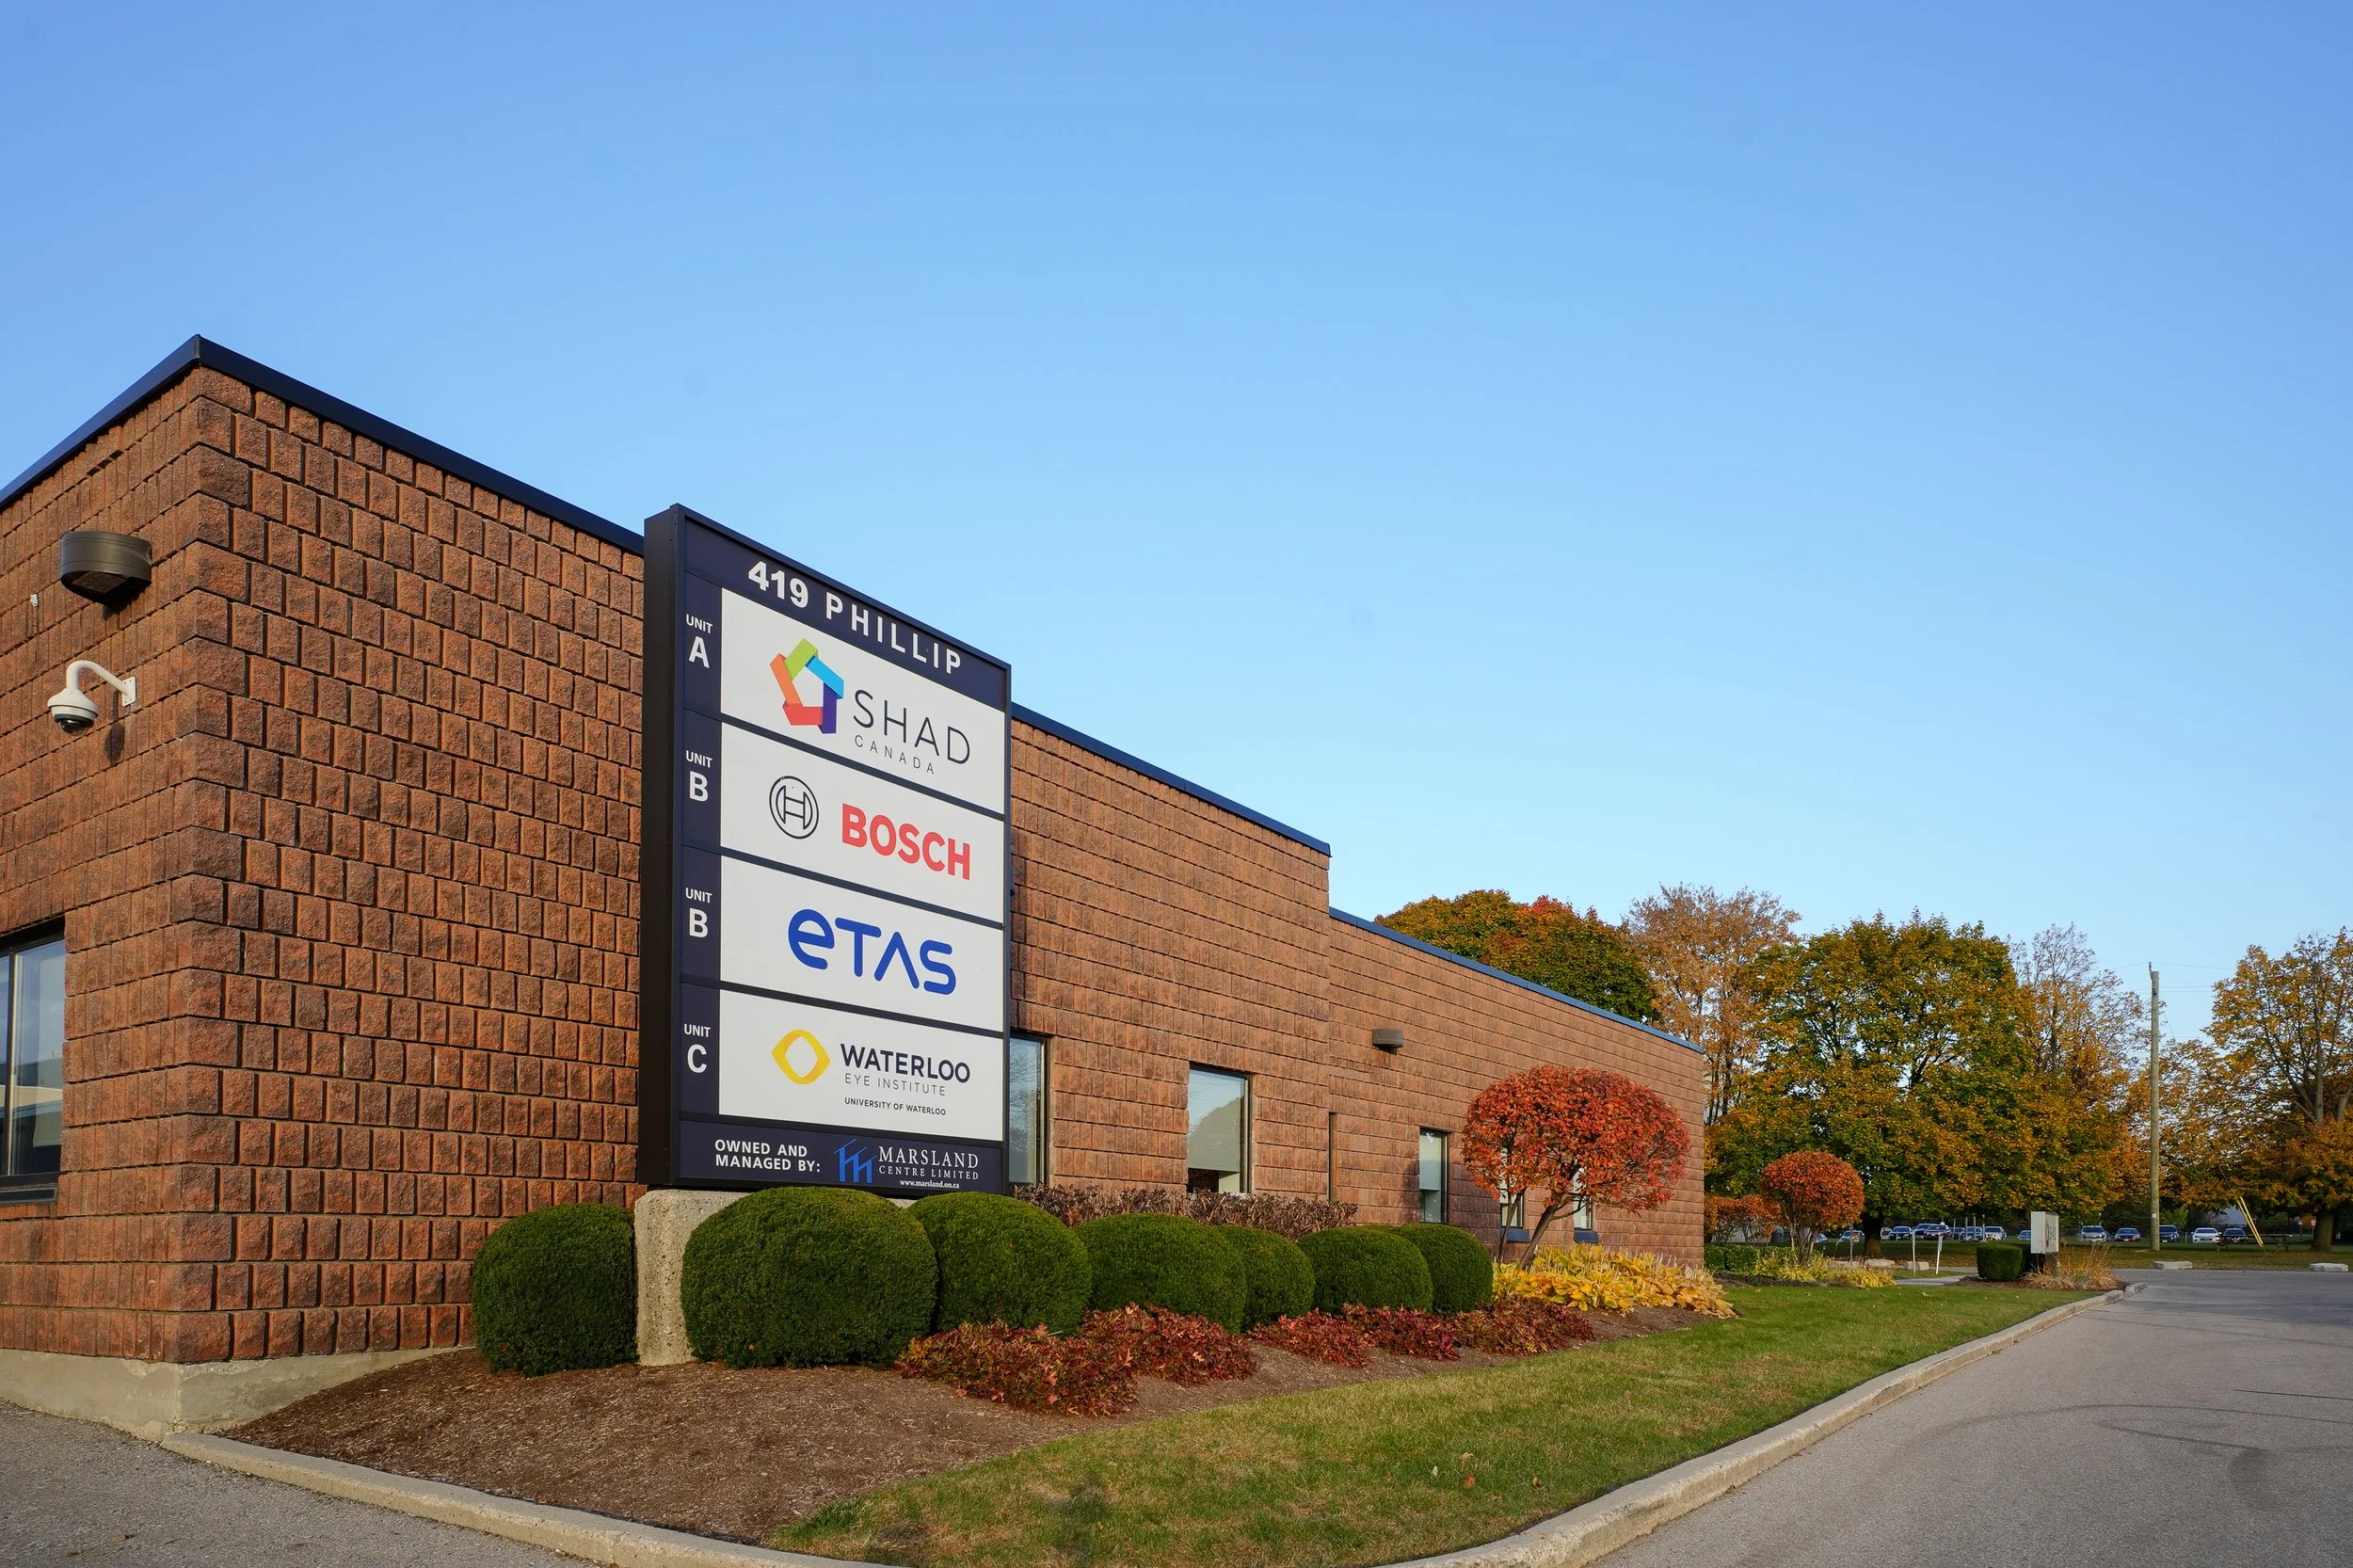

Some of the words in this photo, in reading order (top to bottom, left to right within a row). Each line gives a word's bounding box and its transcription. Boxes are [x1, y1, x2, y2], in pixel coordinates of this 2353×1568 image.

[685, 614, 713, 634] UNIT
[748, 561, 809, 609] 419
[825, 591, 962, 675] PHILLIP
[688, 636, 711, 669] A
[853, 689, 971, 764] SHAD
[685, 750, 712, 769] UNIT
[855, 734, 936, 775] CANADA
[689, 771, 709, 802] B
[841, 803, 970, 881] BOSCH
[685, 887, 712, 904] UNIT
[689, 908, 709, 938] B
[683, 1023, 712, 1038] UNIT
[687, 1044, 708, 1074] C
[840, 1043, 971, 1083] WATERLOO
[844, 1073, 871, 1087] EYE
[877, 1077, 946, 1096] INSTITUTE
[844, 1096, 891, 1110] UNIVERSITY
[893, 1102, 904, 1111] OF
[905, 1105, 947, 1116] WATERLOO
[715, 1139, 771, 1155] OWNED
[777, 1144, 808, 1158] AND
[878, 1145, 979, 1169] MARSLAND
[715, 1154, 792, 1171] MANAGED
[797, 1160, 821, 1173] BY:
[878, 1165, 926, 1176] CENTRE
[931, 1169, 979, 1180] LIMITED
[899, 1179, 960, 1190] www.marsland.on.ca
